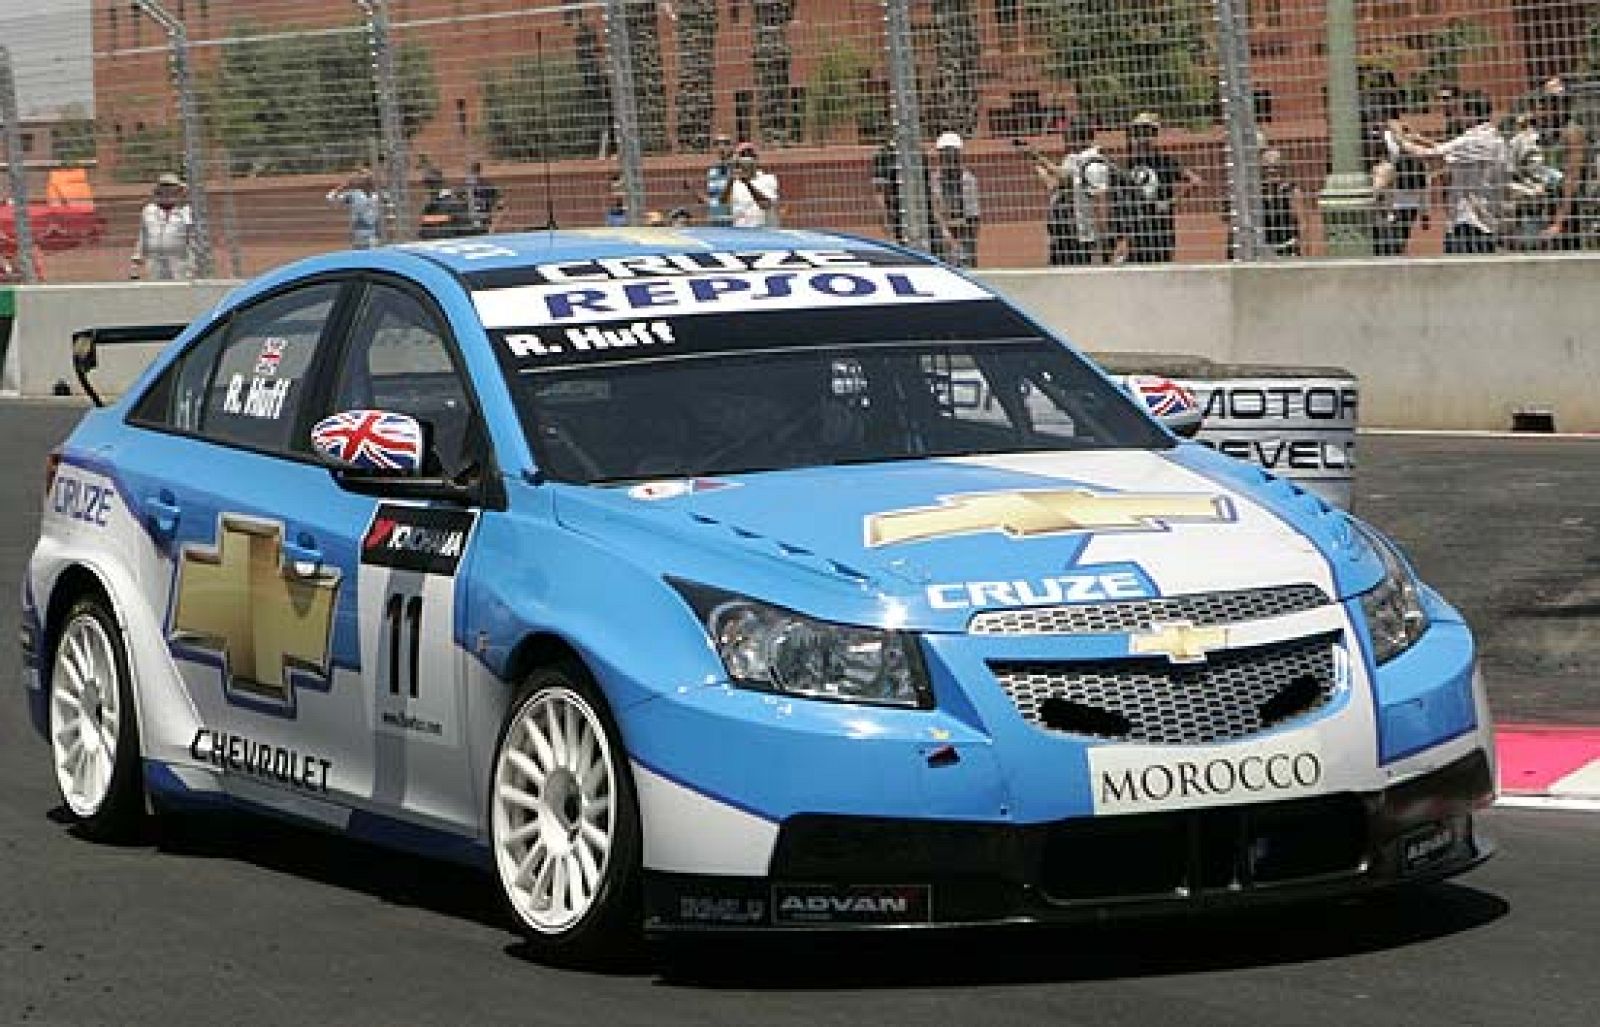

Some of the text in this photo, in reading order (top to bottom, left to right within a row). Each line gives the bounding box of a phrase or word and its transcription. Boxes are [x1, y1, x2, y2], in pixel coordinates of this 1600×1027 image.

[534, 251, 869, 282] CRUZE
[544, 273, 935, 319] REPSOL
[505, 332, 562, 358] R.
[54, 477, 114, 527] CRUZE
[927, 571, 1147, 610] CRUZE
[387, 593, 423, 699] 11
[191, 729, 332, 793] CHEVROLET
[1101, 752, 1321, 805] MOROCCO
[780, 895, 907, 912] ADVAN
